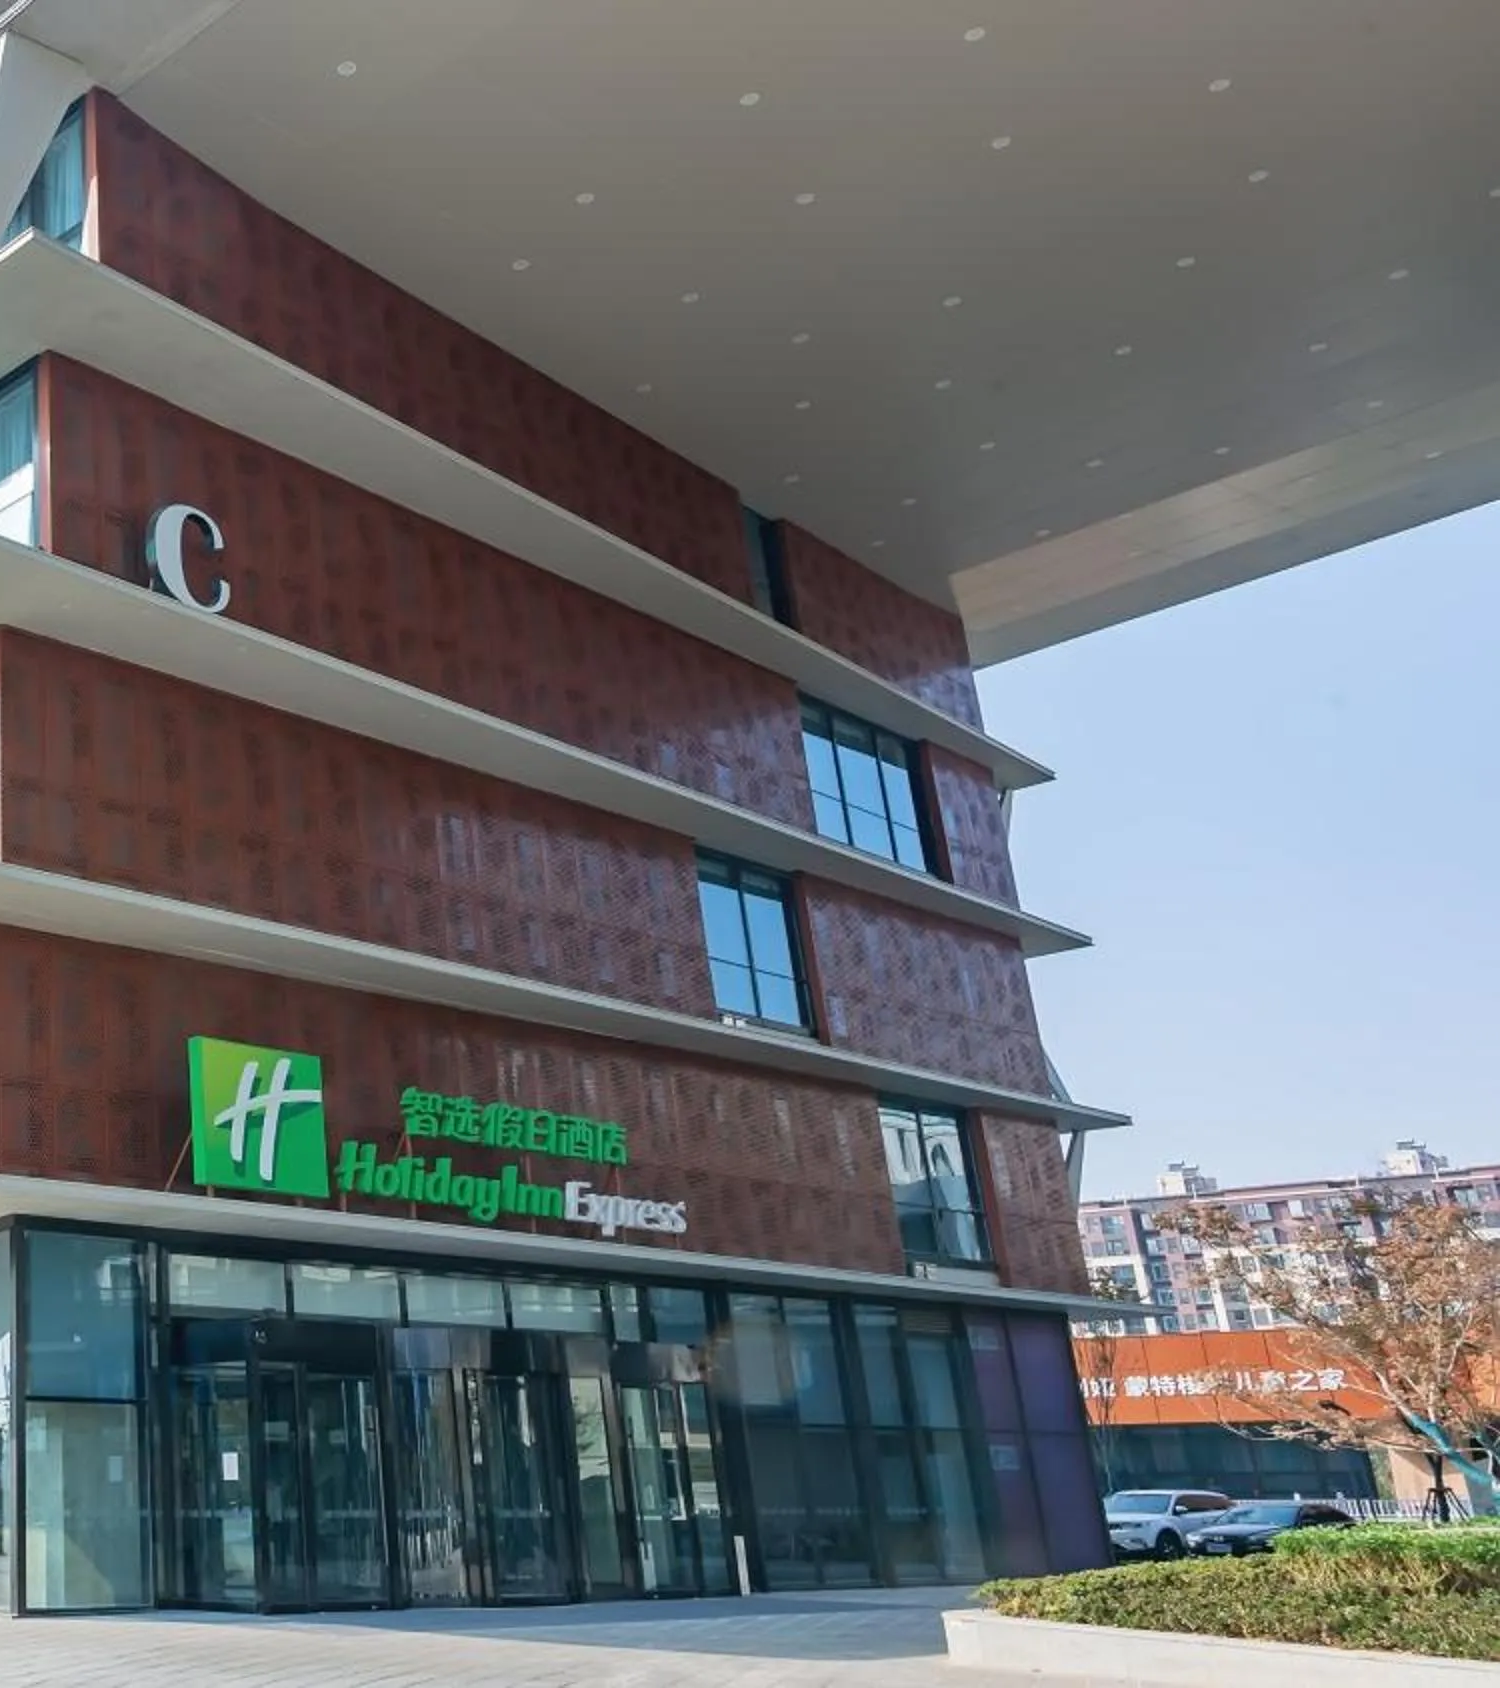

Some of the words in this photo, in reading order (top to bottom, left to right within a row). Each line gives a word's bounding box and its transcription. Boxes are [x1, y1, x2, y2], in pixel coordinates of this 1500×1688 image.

[148, 504, 231, 614] C
[400, 1086, 628, 1165] 智选假日酒店
[334, 1140, 500, 1222] Holiday
[501, 1165, 564, 1218] Inn
[564, 1179, 688, 1236] Express
